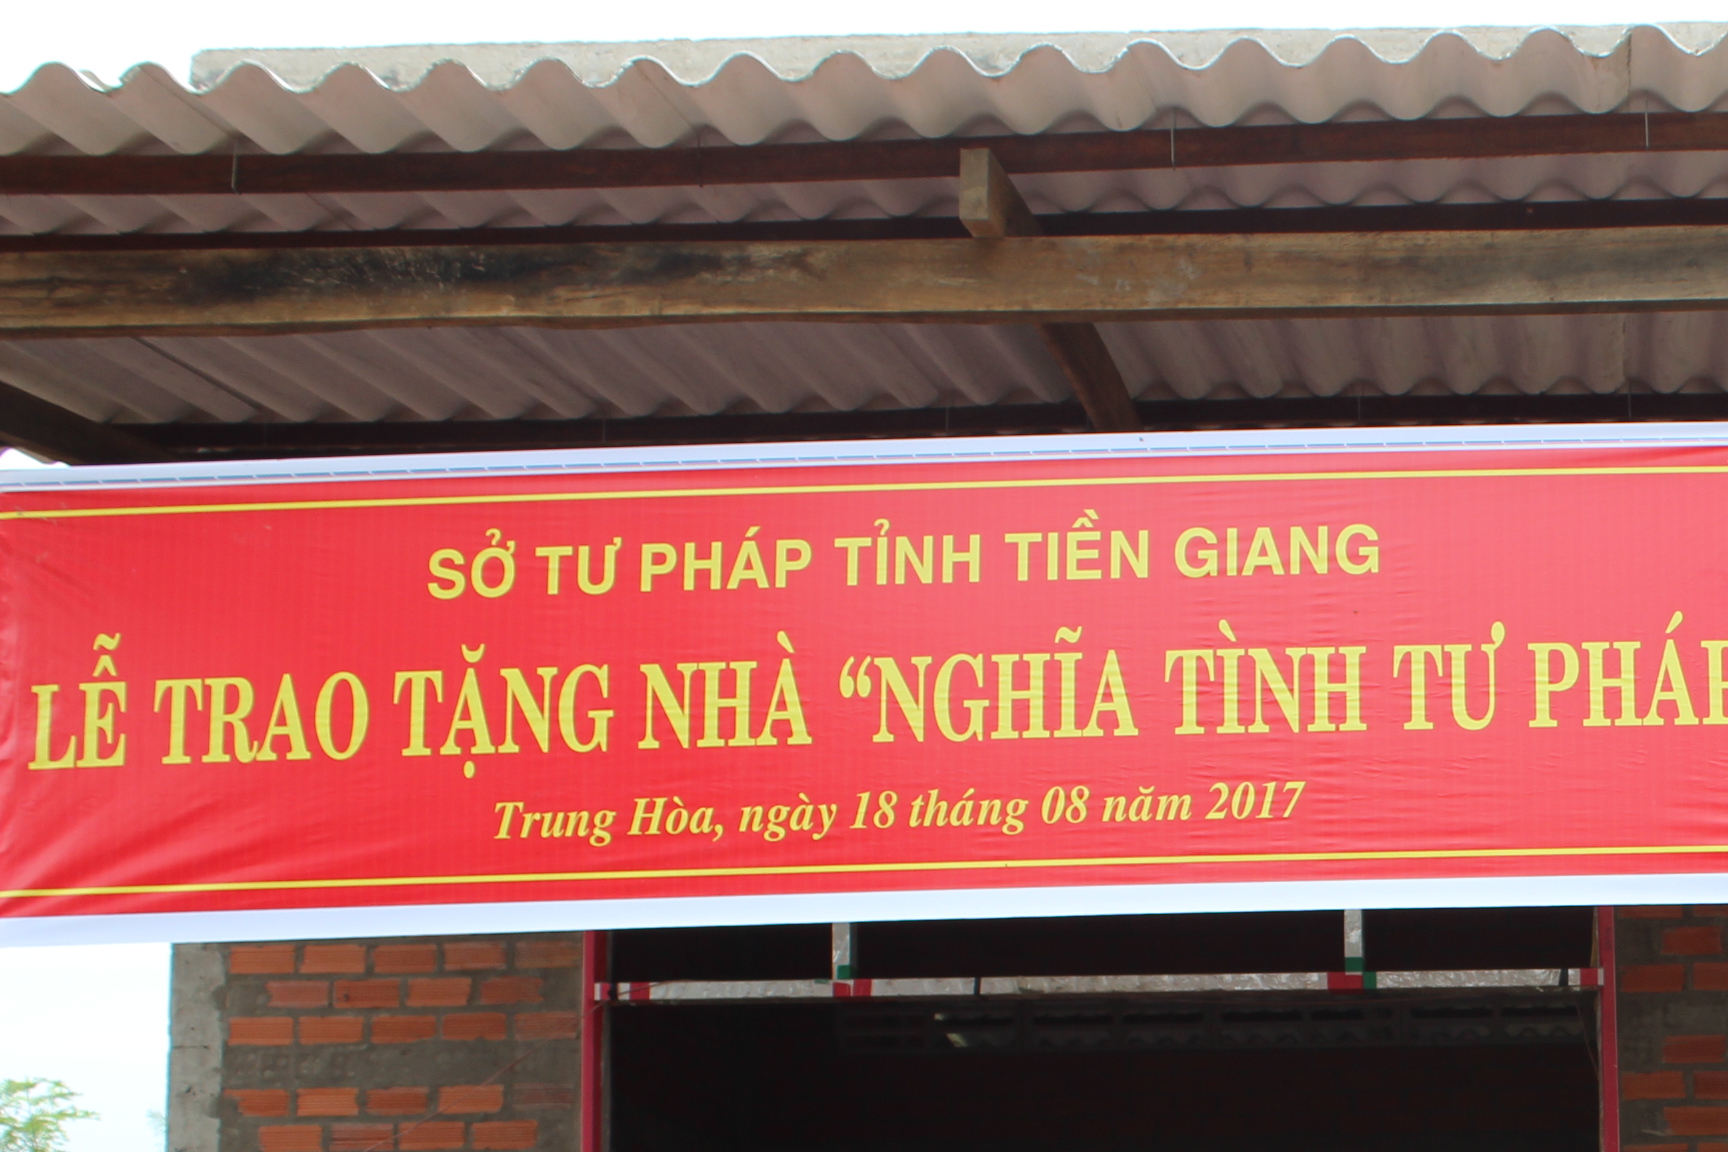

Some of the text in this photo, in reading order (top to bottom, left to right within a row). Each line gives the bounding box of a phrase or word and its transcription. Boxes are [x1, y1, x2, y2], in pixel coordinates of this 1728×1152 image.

[428, 508, 1380, 599] SỞ TƯ PHÁP TỈNH TIỀN GIANG
[28, 632, 127, 771] LỄ
[153, 667, 369, 764] TRAO
[393, 643, 615, 779] TẶNG
[637, 630, 813, 750] NHÀ
[839, 625, 1140, 743] “NGHĨA
[1164, 618, 1369, 736] TÌNH
[1392, 620, 1507, 732] TƯ
[493, 780, 1307, 846] Trung Hòa, ngày 18 tháng 08 năm 2017
